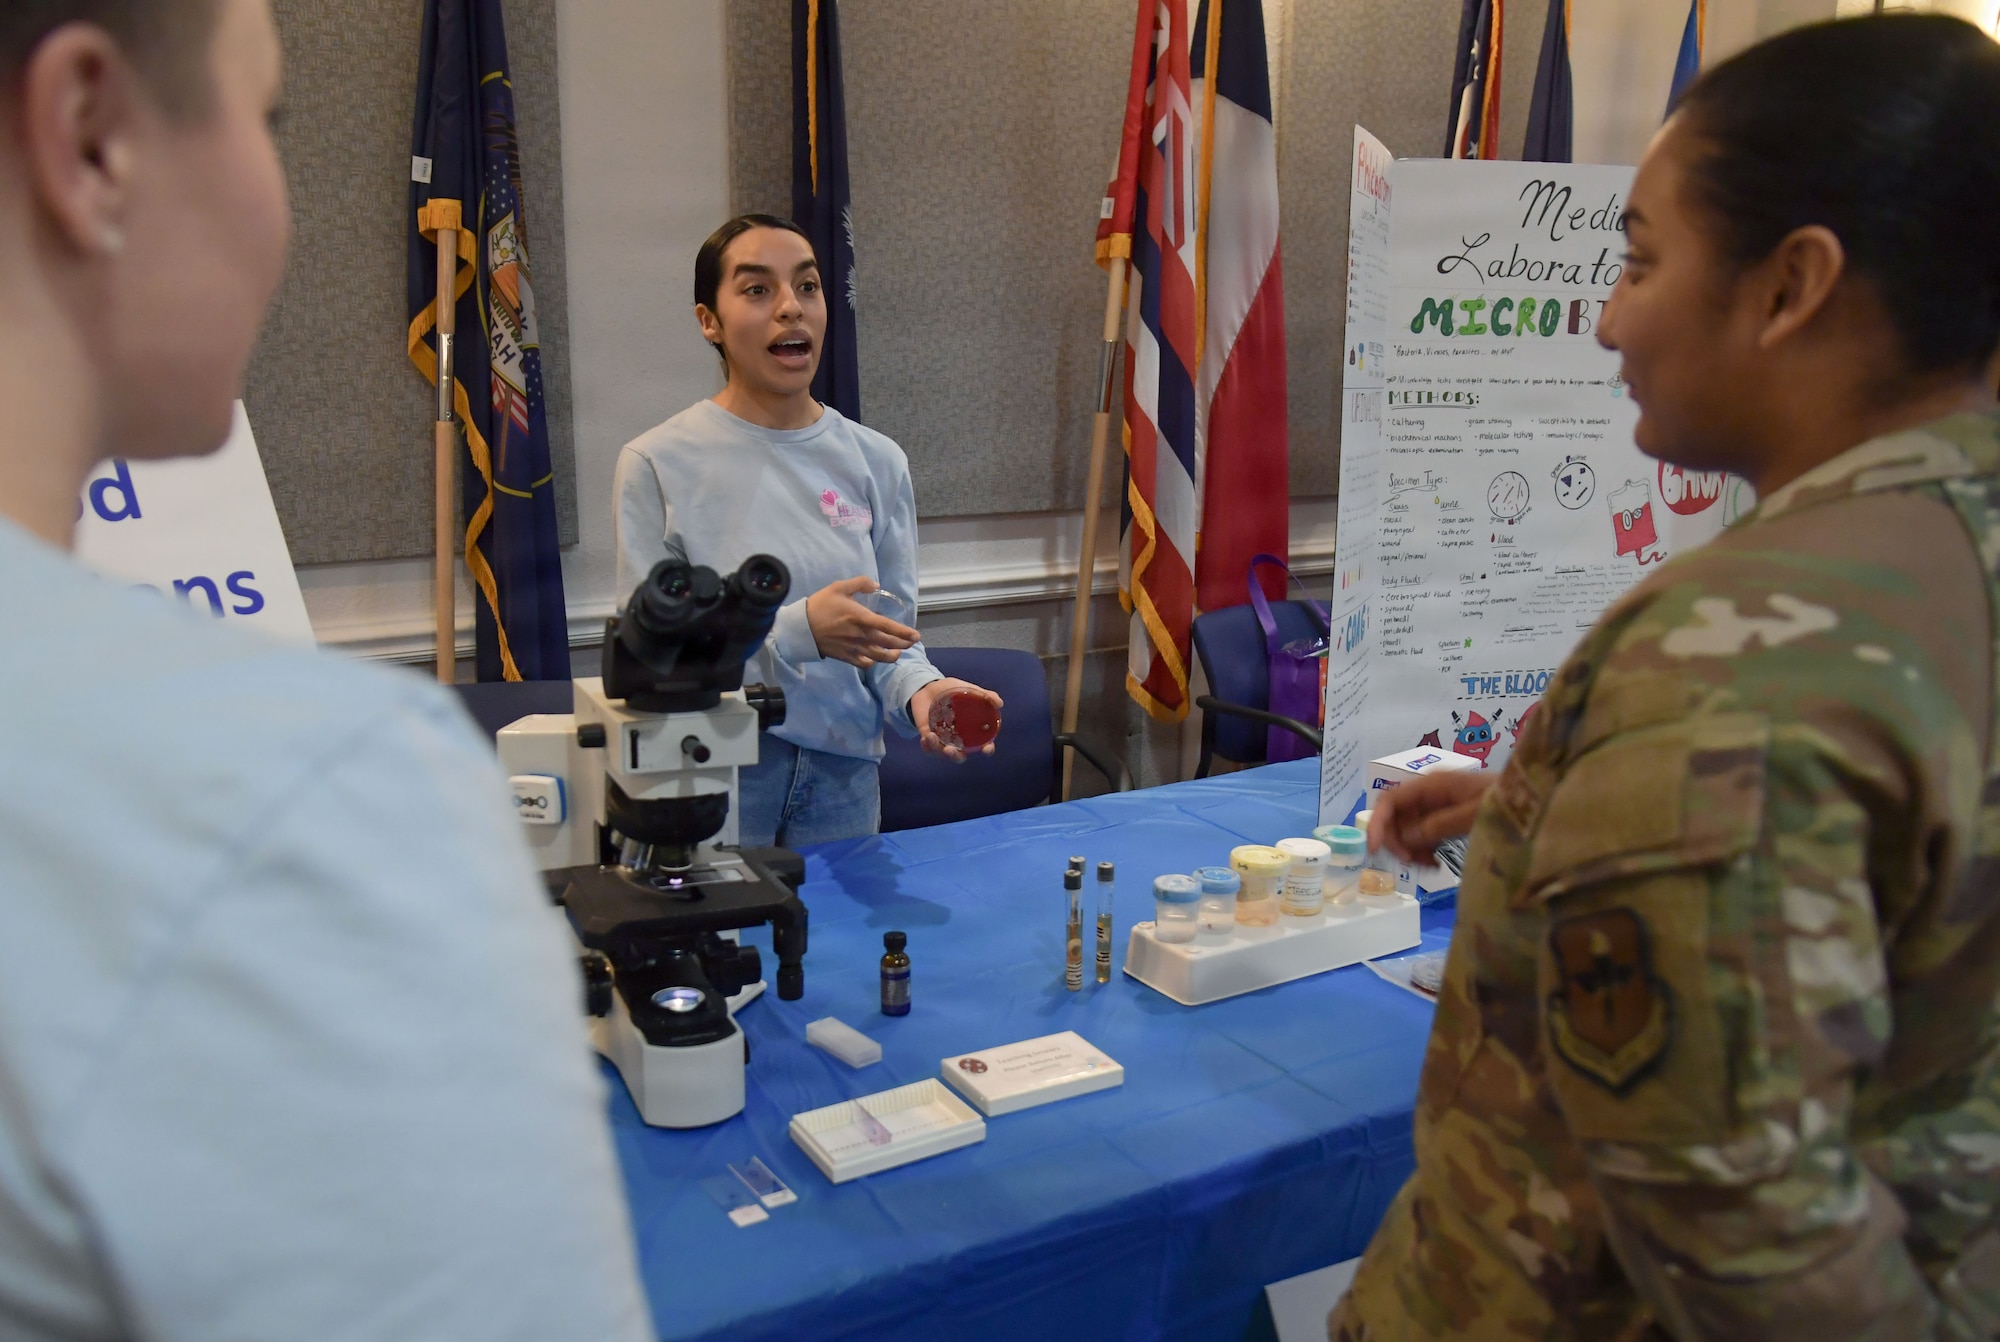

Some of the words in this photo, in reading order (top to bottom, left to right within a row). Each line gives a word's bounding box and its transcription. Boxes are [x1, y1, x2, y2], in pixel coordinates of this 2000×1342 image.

[1388, 391, 1479, 405] METHODS:
[1388, 472, 1420, 489] Specimen
[1460, 676, 1502, 695] THE
[1505, 671, 1555, 694] BLOO
